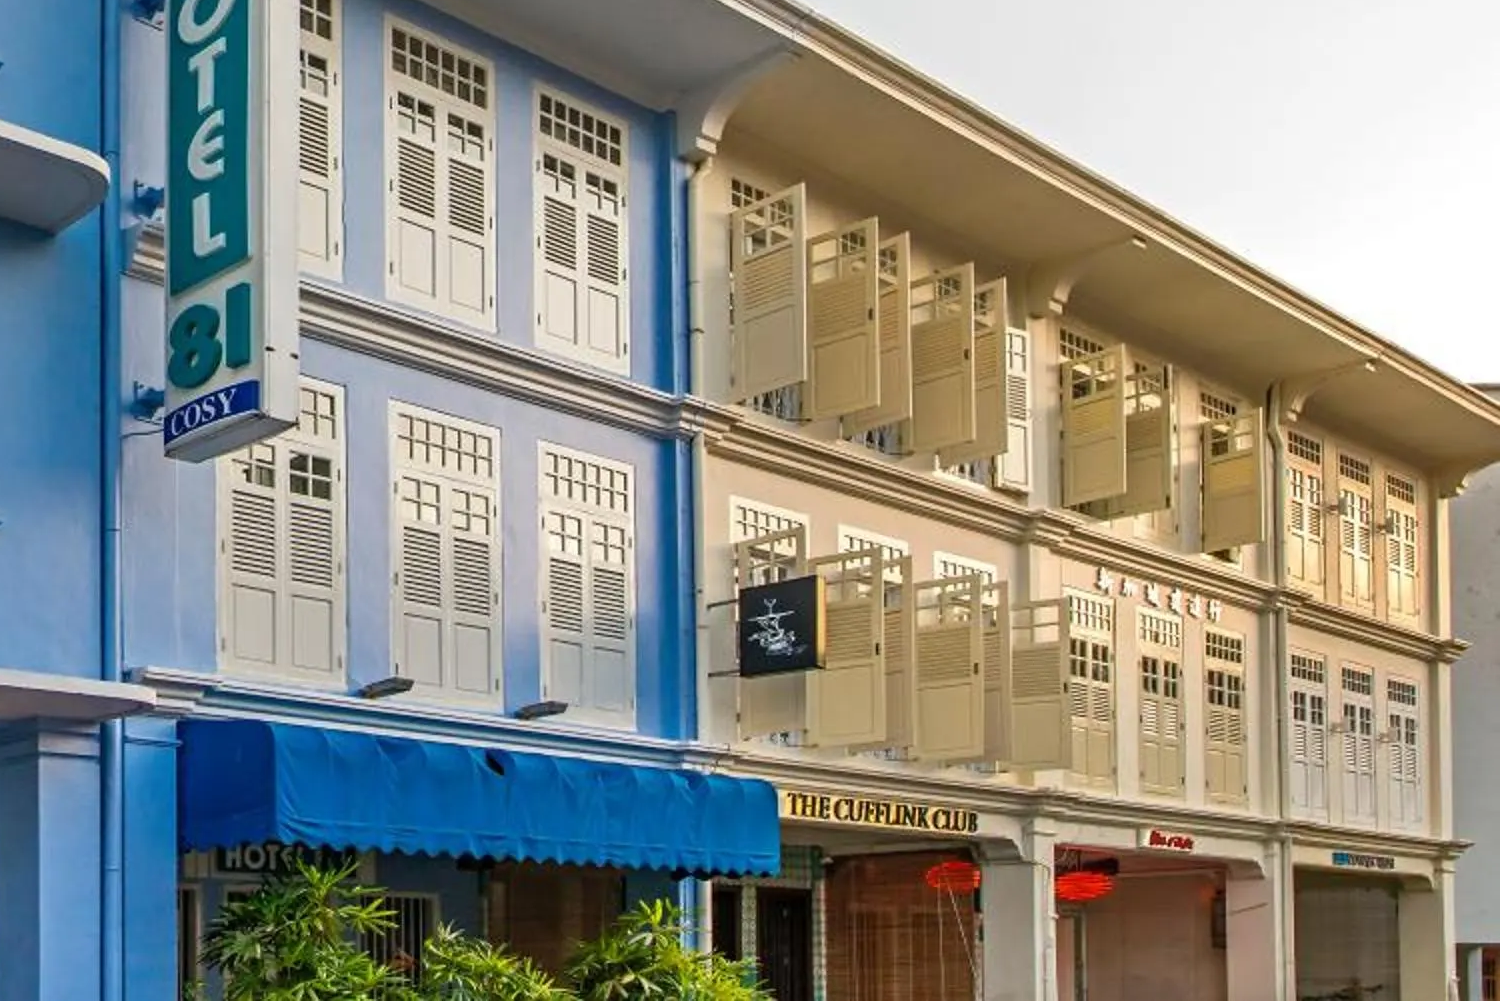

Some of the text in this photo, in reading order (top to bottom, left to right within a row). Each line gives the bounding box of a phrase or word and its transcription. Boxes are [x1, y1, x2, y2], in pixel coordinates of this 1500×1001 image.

[167, 282, 251, 390] 81
[171, 388, 238, 436] COSY
[787, 792, 978, 833] THE CUFFLINK CLUB
